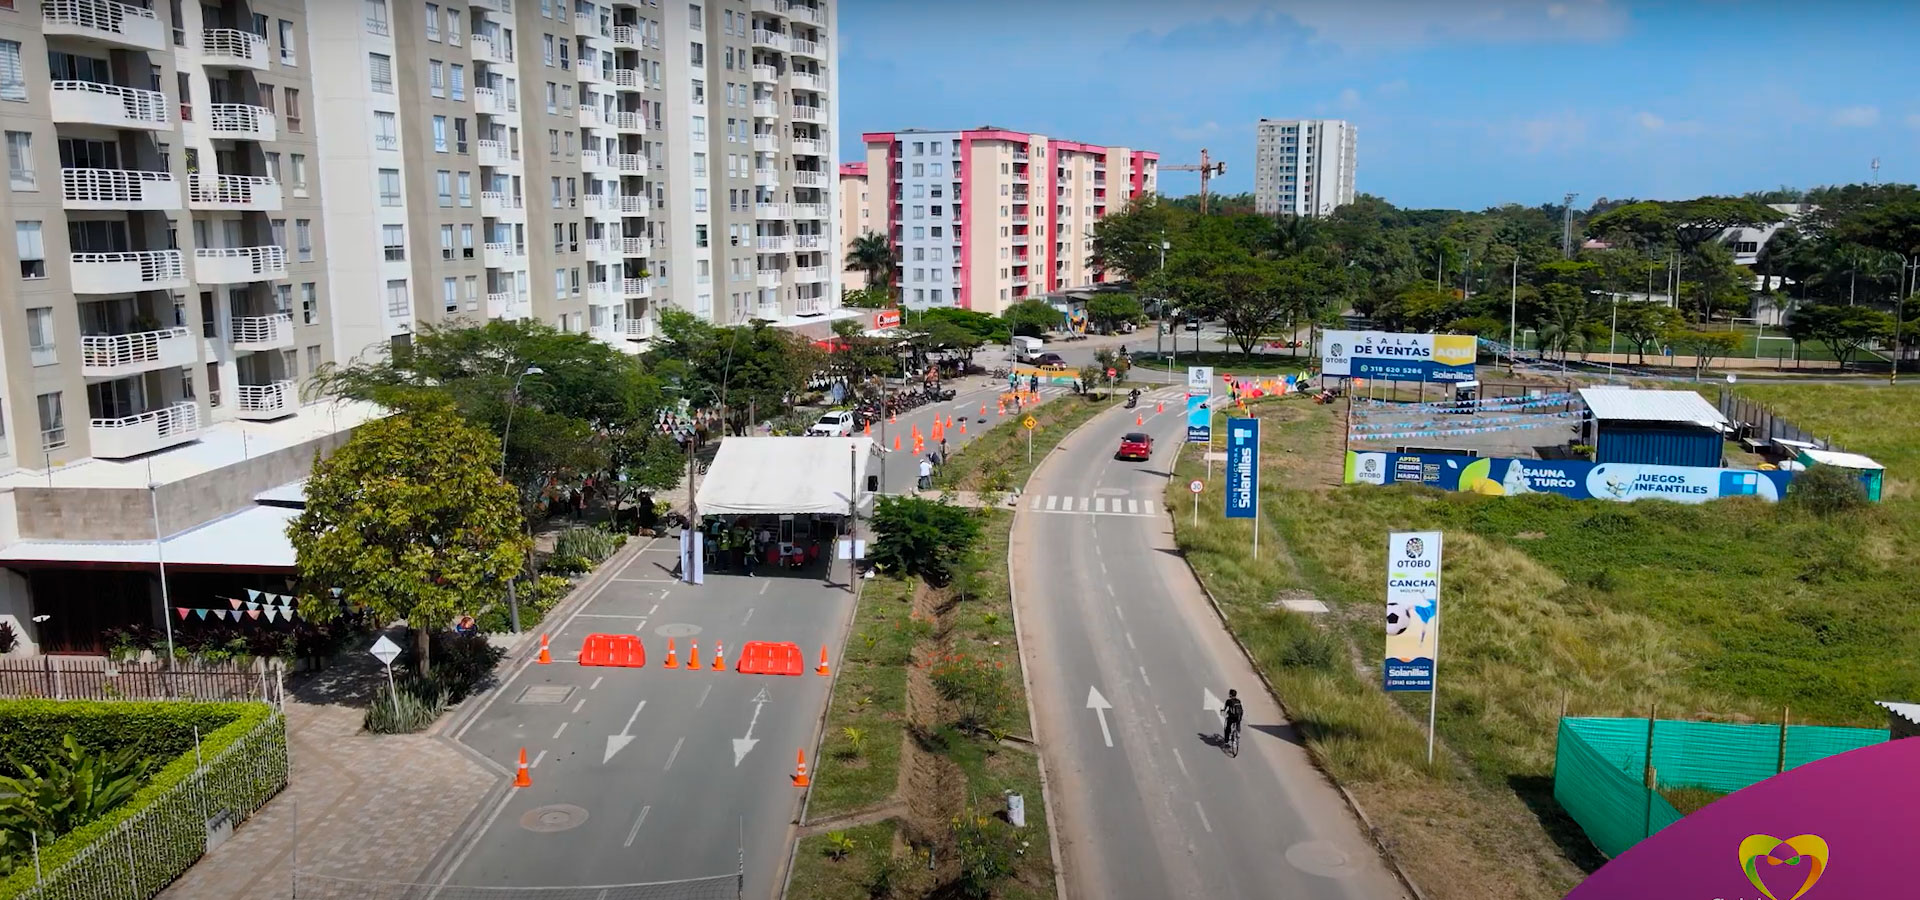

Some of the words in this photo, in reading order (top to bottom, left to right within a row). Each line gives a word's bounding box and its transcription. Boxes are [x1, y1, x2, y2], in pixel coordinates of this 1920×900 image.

[1366, 336, 1419, 346] SALA
[1354, 345, 1372, 354] DE
[1377, 346, 1430, 357] VENTAS
[1370, 365, 1384, 373] 318
[1385, 366, 1400, 374] 620
[1432, 371, 1474, 381] Solanillas
[1238, 447, 1252, 508] Solanillas
[1523, 467, 1566, 479] SAUNA
[1536, 479, 1576, 488] TURCO
[1635, 473, 1686, 484] JUEGOS
[1634, 483, 1708, 495] INFANTILES
[1397, 559, 1431, 568] OTOBO
[1389, 580, 1436, 588] CANCHA
[1388, 668, 1430, 677] Solanillas
